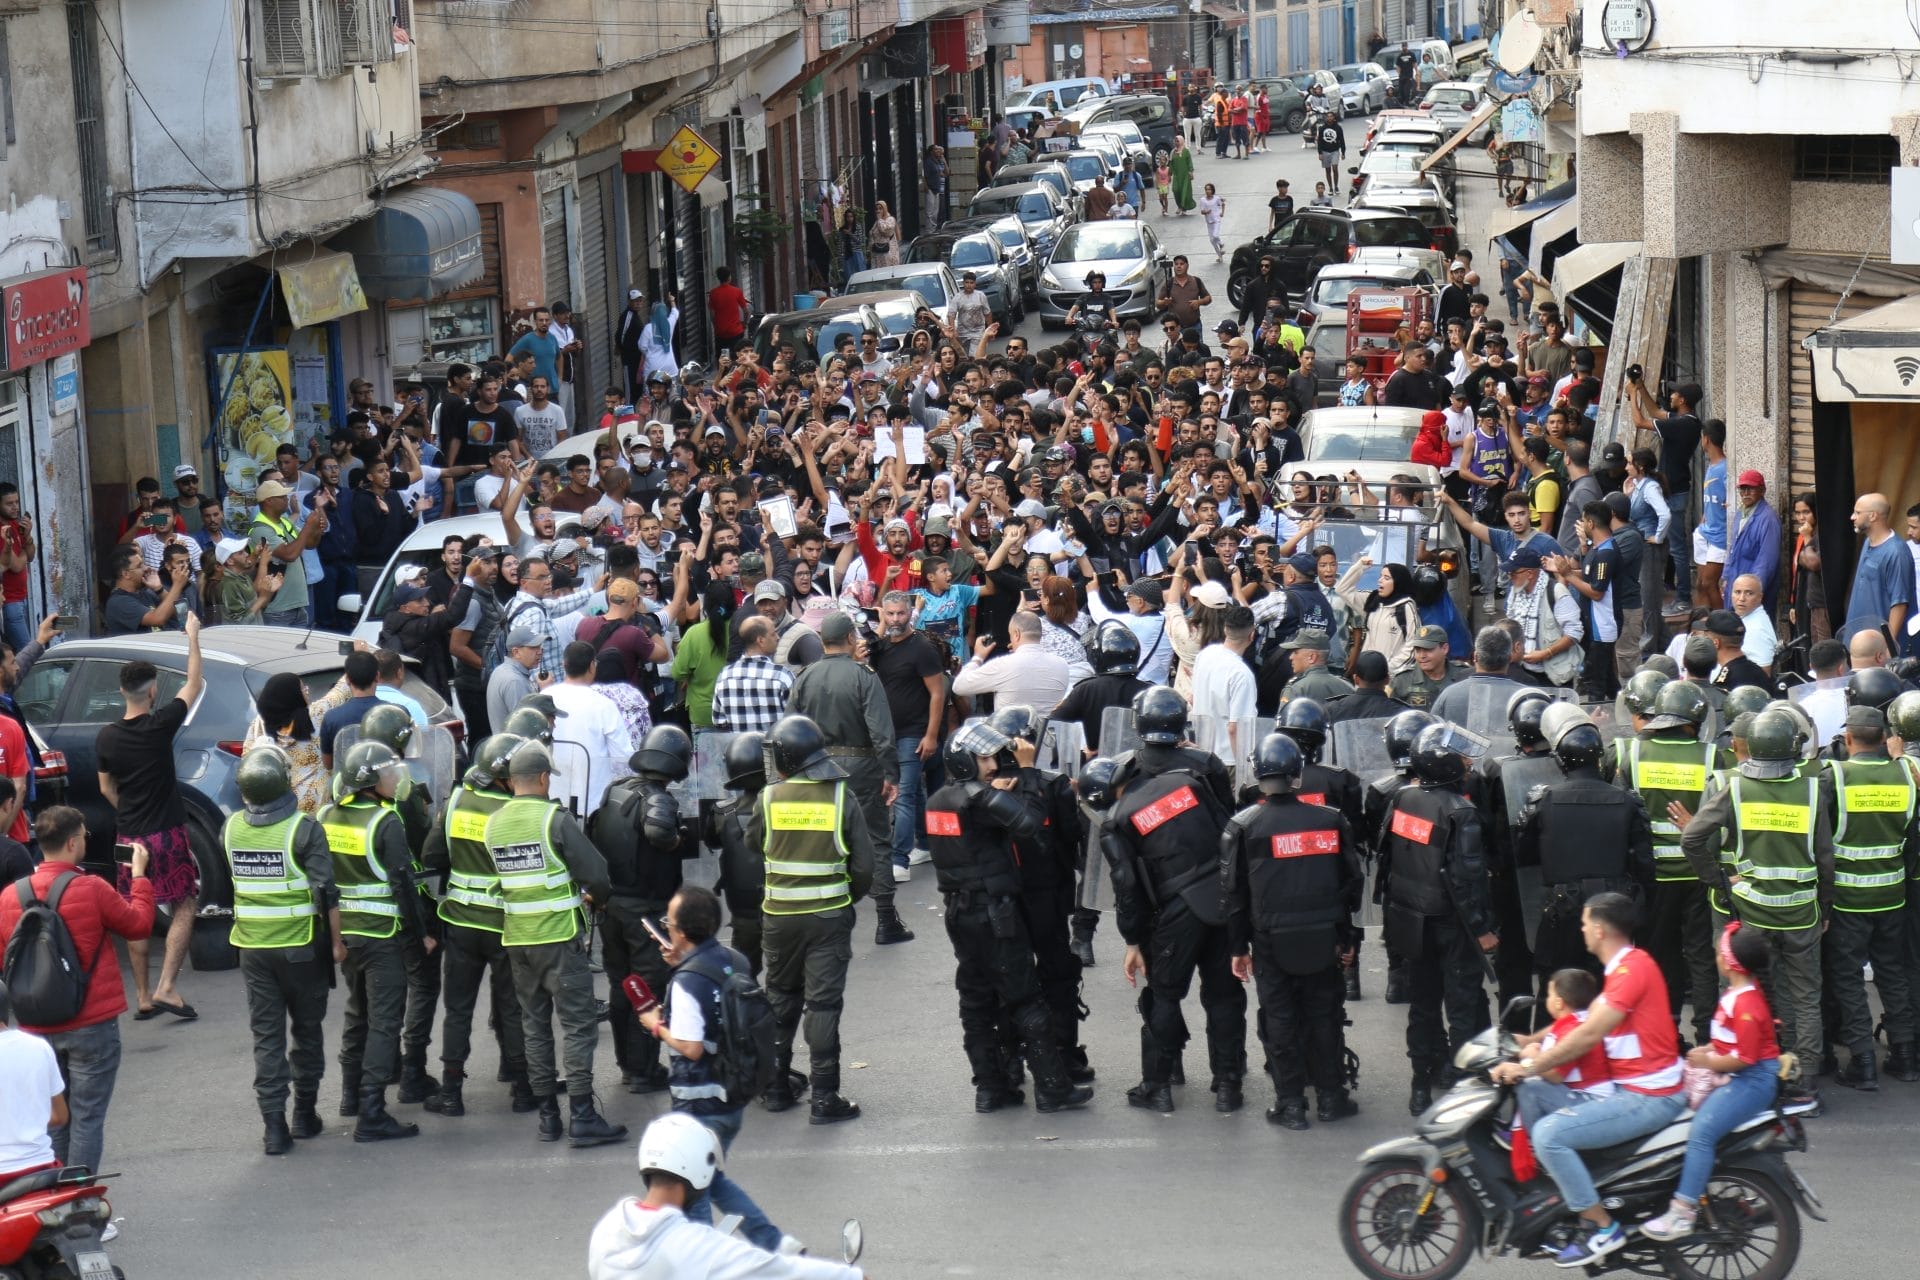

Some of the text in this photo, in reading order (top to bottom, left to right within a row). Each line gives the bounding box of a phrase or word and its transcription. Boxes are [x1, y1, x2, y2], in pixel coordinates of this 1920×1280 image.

[1135, 804, 1164, 832] POLICE
[1275, 833, 1304, 857] POLICE
[1315, 832, 1338, 852] شرطة
[232, 852, 282, 866] القوات المساعدة
[496, 856, 544, 871] FORCES AUXILIAIRES
[233, 864, 283, 876] FORCES AUXILIAIRES
